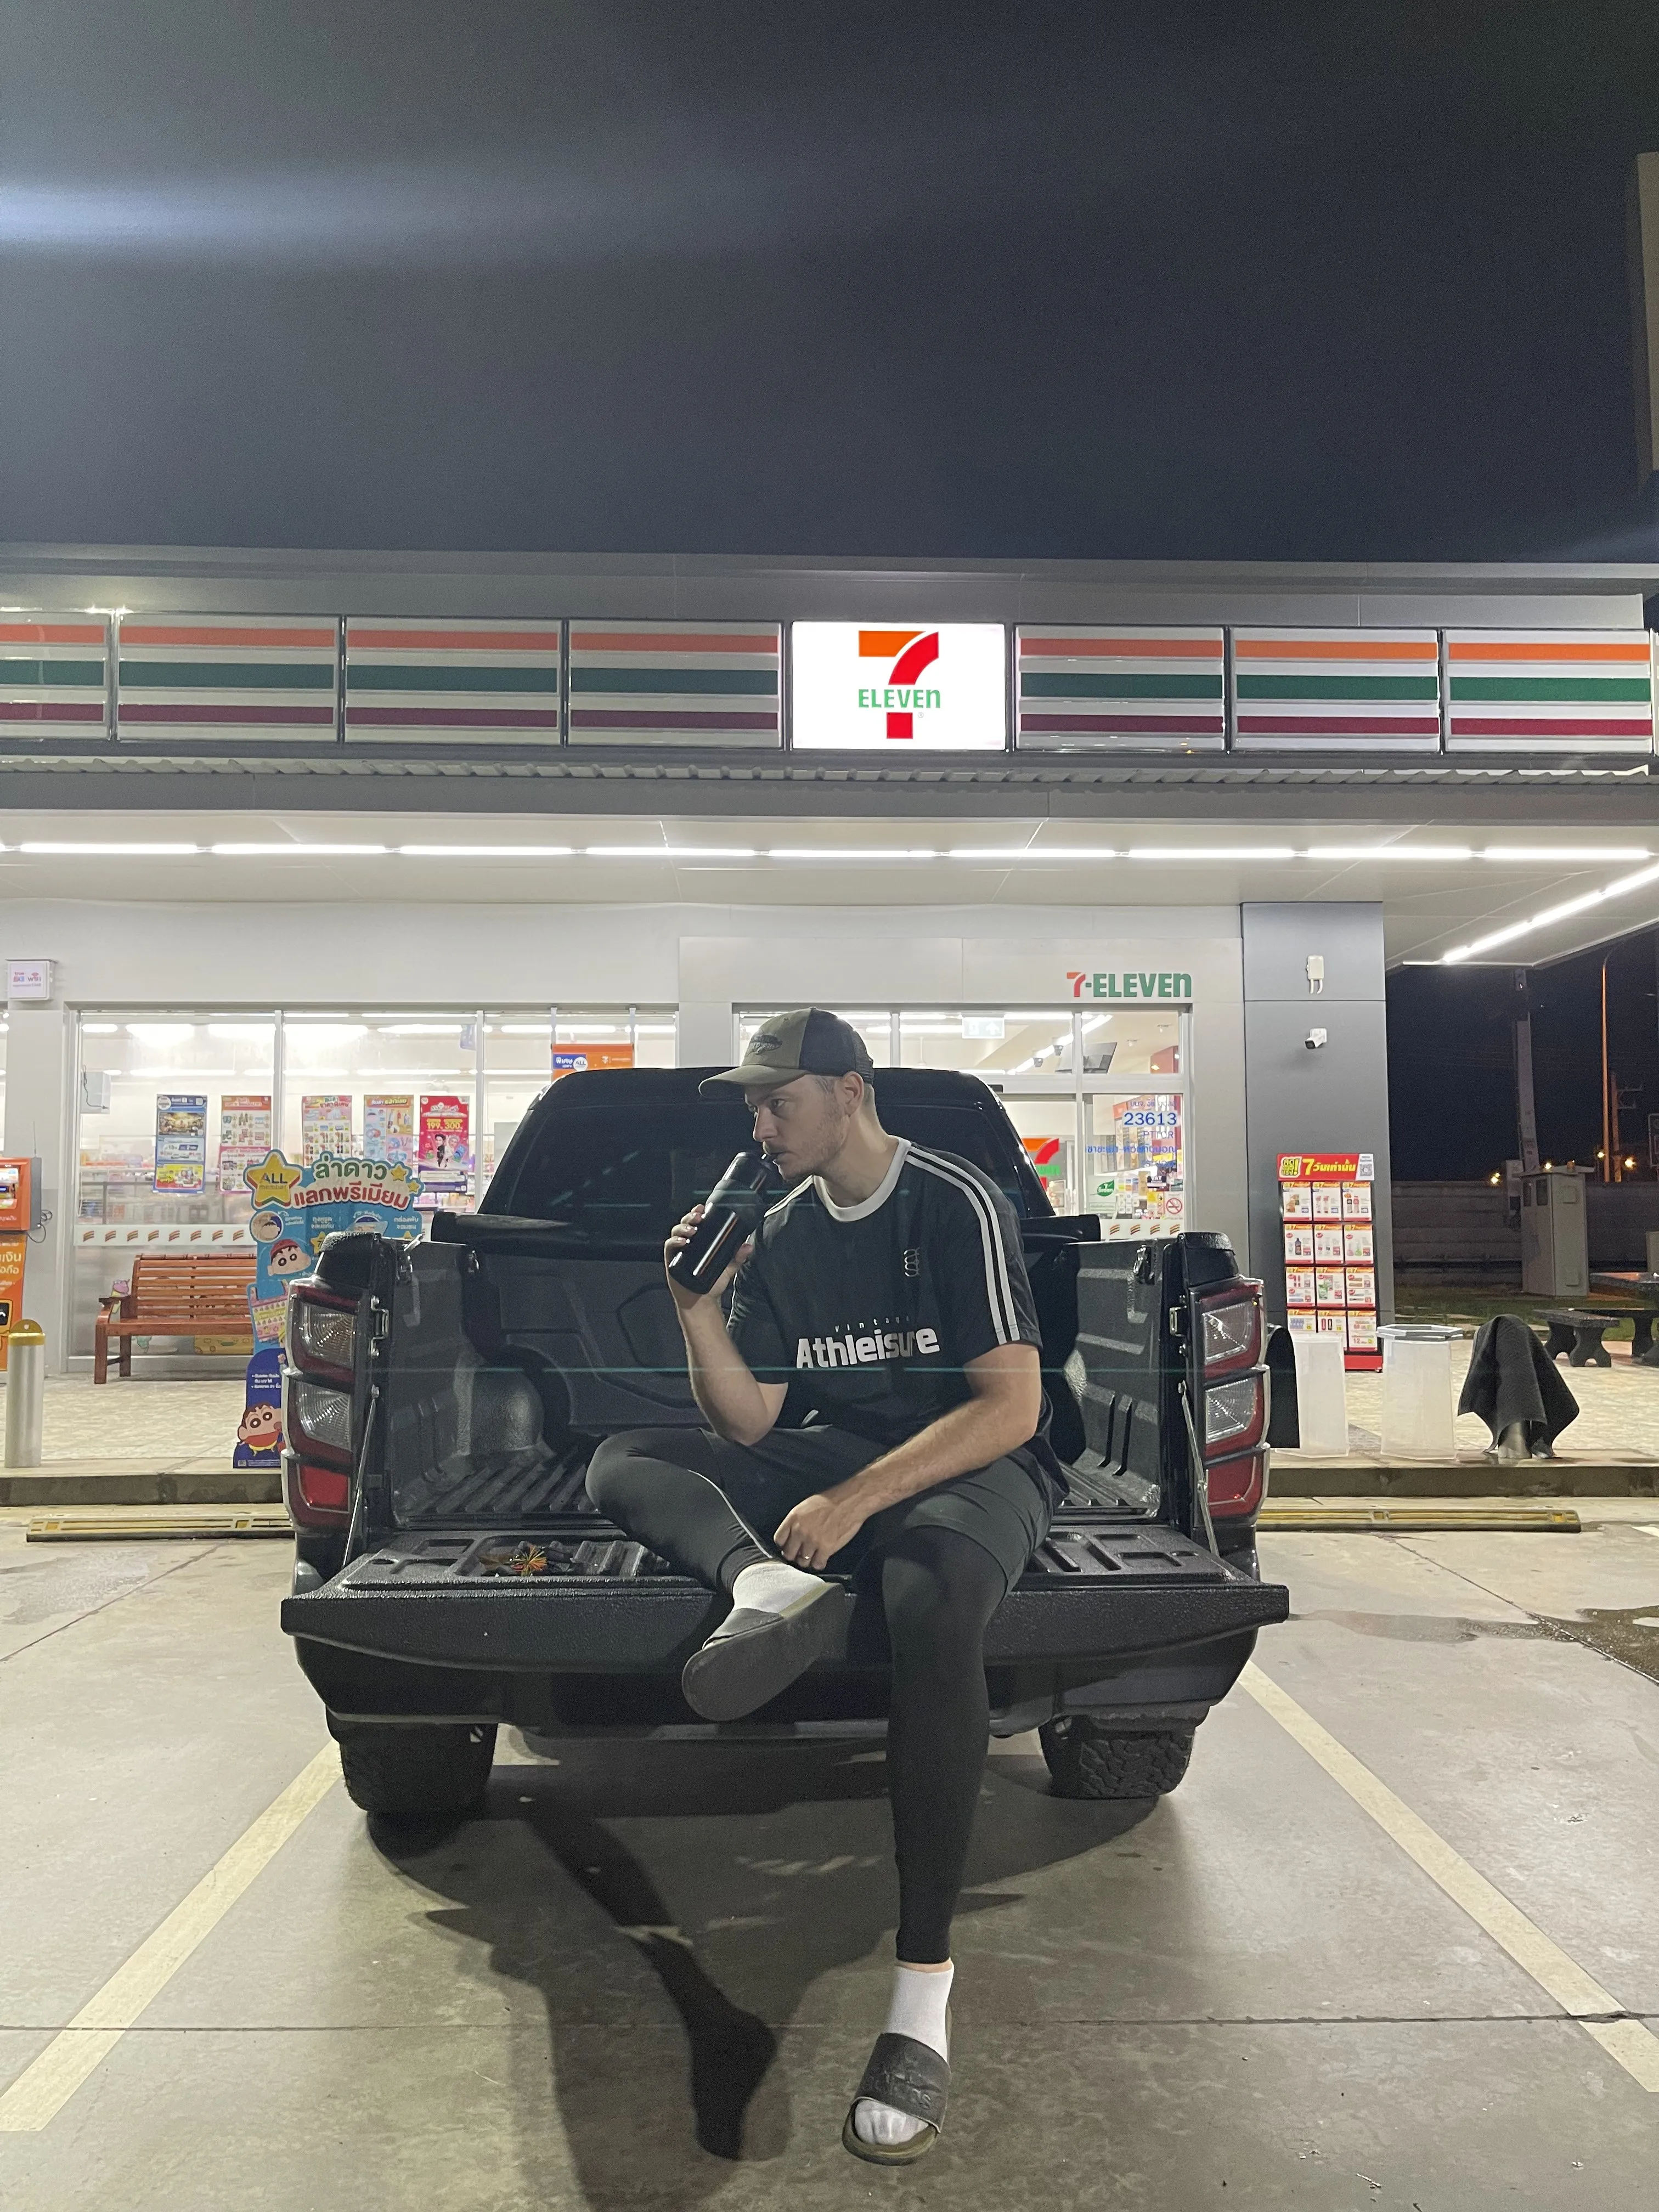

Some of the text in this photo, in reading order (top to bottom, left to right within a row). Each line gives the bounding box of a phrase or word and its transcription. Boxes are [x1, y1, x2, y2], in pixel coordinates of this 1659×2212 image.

[859, 630, 939, 739] 7
[1124, 1112, 1177, 1126] 23613
[315, 1155, 387, 1180] ล่าดาว
[1302, 1158, 1356, 1176] 7 วันเท่านั้น
[259, 1172, 288, 1184] ALL
[294, 1181, 409, 1208] แลกพรีเมียม
[0, 1264, 20, 1274] อถือ
